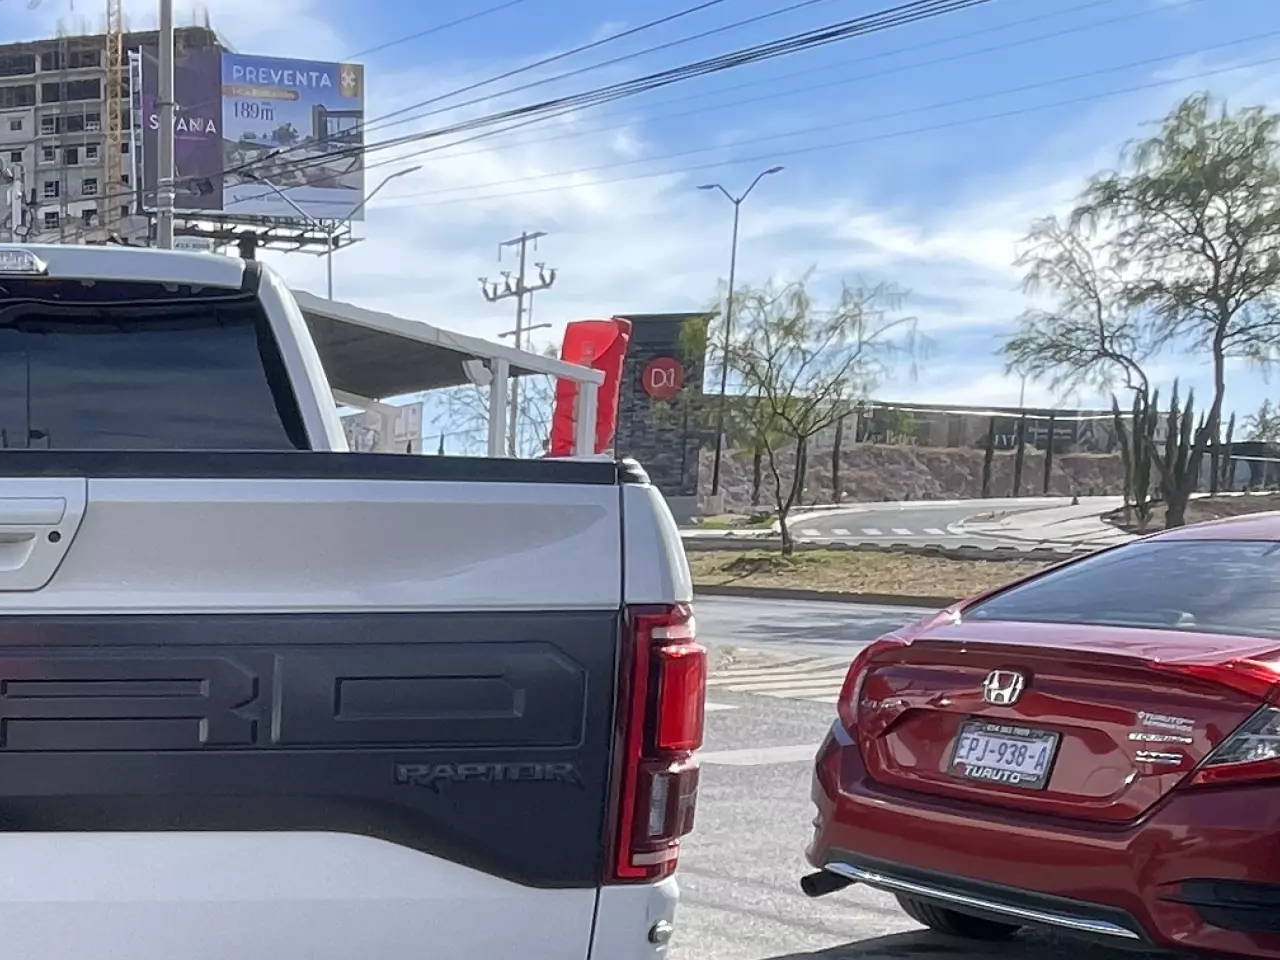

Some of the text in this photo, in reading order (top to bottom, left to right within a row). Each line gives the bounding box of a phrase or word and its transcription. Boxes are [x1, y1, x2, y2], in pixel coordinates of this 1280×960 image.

[232, 65, 332, 88] PREVENTA
[651, 367, 675, 388] D1
[394, 761, 585, 795] RAPTOR
[964, 765, 1021, 784] TUAUTO
